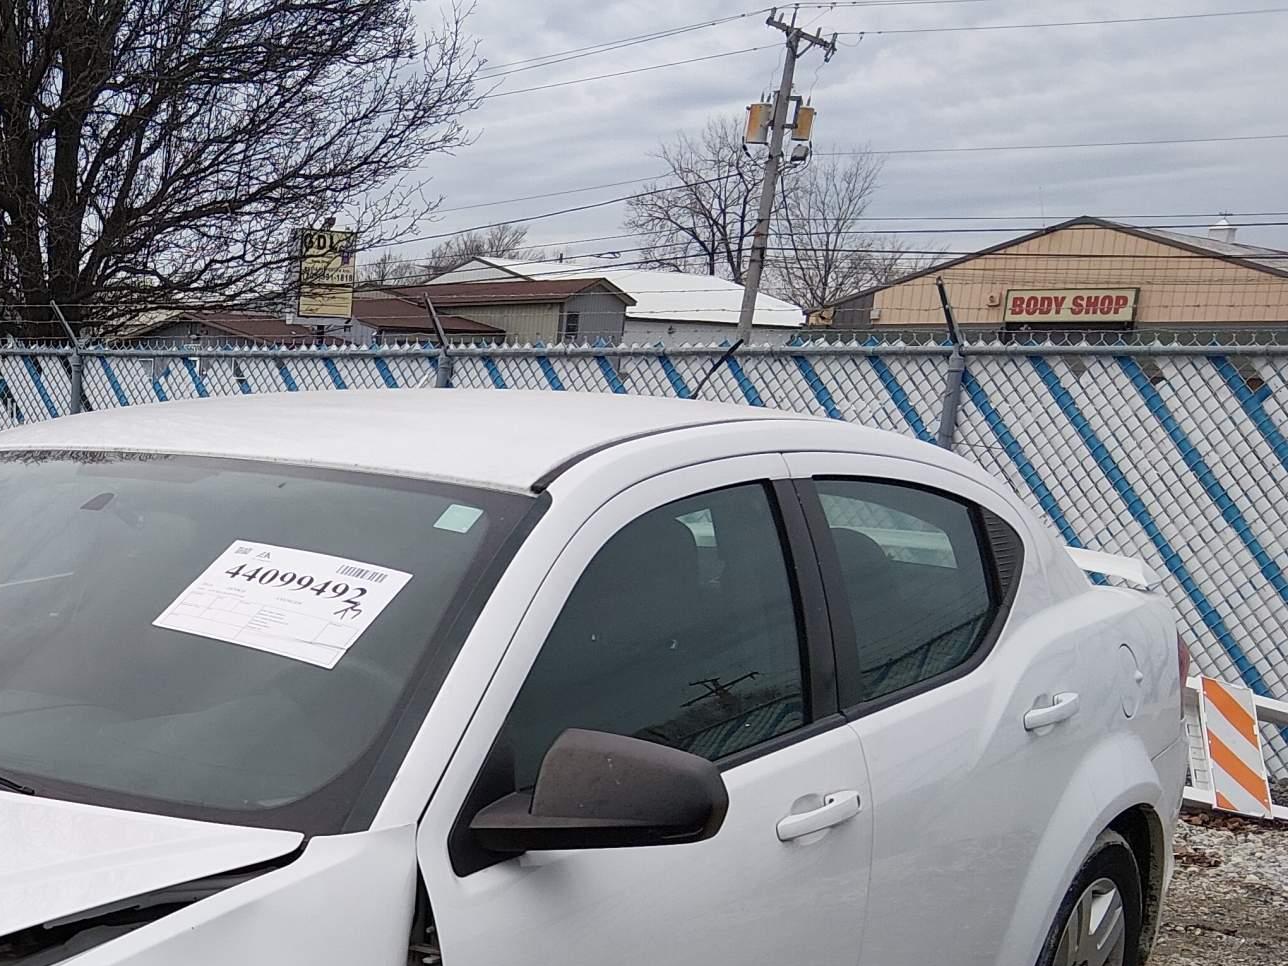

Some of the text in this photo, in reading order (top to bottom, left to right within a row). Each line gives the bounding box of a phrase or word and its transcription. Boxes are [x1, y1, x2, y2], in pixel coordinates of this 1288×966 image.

[1010, 295, 1129, 316] BODY SHOP
[224, 563, 368, 605] 44099492
